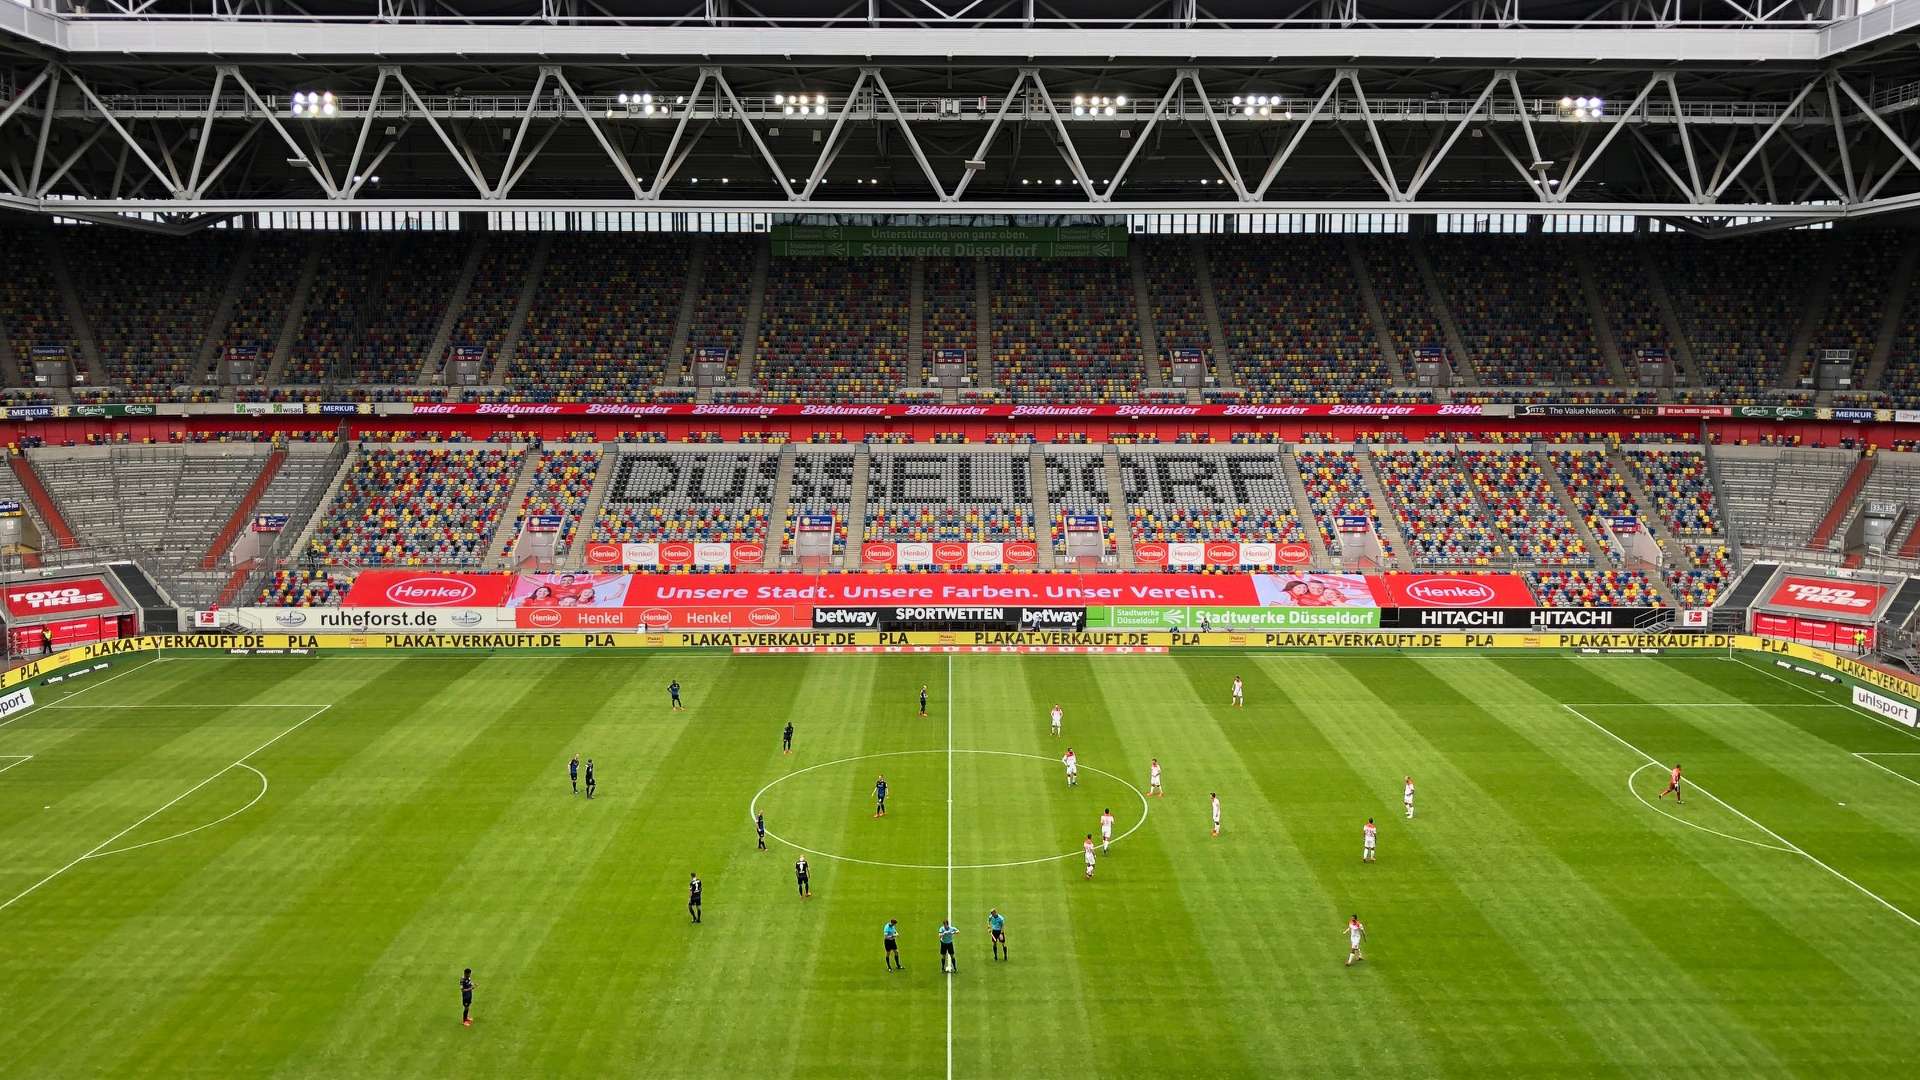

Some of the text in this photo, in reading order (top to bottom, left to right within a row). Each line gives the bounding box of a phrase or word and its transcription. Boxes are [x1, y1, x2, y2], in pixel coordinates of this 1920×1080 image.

[871, 229, 1029, 240] Unterstützung von ganz oben.
[863, 242, 1040, 256] Stadtwerke Düsseldorf
[11, 408, 49, 416] MERKUR
[323, 404, 355, 412] MERKUR
[476, 404, 562, 415] Böklunder
[586, 404, 672, 415] Böklunder
[692, 404, 778, 415] Böklunder
[800, 405, 885, 415] Böklunder
[905, 405, 989, 416] Böklunder
[1011, 405, 1096, 416] Böklunder
[1116, 405, 1201, 415] Böklunder
[1223, 405, 1308, 415] Böklunder
[1329, 405, 1414, 415] Böklunder
[1585, 407, 1617, 415] Network
[1836, 411, 1872, 419] MERKUR
[592, 550, 618, 558] Henkel
[628, 550, 655, 558] Henkel
[664, 550, 689, 558] Henkel
[700, 550, 727, 558] Henkel
[735, 550, 761, 558] Henkel
[867, 549, 892, 557] Henkel
[903, 549, 928, 557] Henkel
[938, 549, 963, 557] Henkel
[973, 549, 998, 557] Henkel
[1008, 549, 1034, 557] Henkel
[1138, 550, 1164, 558] Henkel
[1174, 550, 1200, 558] Henkel
[1210, 550, 1235, 558] Henkel
[1246, 550, 1270, 558] Henkel
[1281, 550, 1306, 558] Henkel
[9, 588, 80, 601] TOYO
[395, 586, 468, 598] Henkel
[656, 586, 1224, 599] Unsere Stadt. Unsere Farben. Unser Verein.
[1414, 586, 1487, 598] Henkel
[1787, 584, 1856, 597] TOYO
[28, 592, 104, 608] TIRES
[1795, 592, 1872, 608] TIRES
[533, 613, 559, 622] Henkel
[643, 613, 670, 622] Henkel
[687, 611, 732, 624] Henkel
[751, 612, 778, 621] Henkel
[816, 608, 1084, 627] betway SPORTWETTEN betway
[1116, 608, 1160, 617] Stadtwerke
[1196, 610, 1374, 625] Stadtwerke Düsseldorf
[1421, 611, 1504, 625] HITACHI
[1530, 611, 1612, 625] HITACHI
[320, 611, 437, 626] ruheforst.de
[578, 612, 624, 625] Henkel
[1116, 616, 1160, 625] Düsseldorf
[288, 635, 319, 648] PLA
[386, 635, 561, 647] PLAKAT-VERKAUFT.DE
[585, 634, 615, 647] PLA
[683, 633, 856, 647] PLAKAT-VERKAUFT.DE
[880, 632, 909, 645] PLA
[975, 632, 1149, 646] PLAKAT-VERKAUFT.DE
[1171, 633, 1200, 646] PLA
[1266, 633, 1442, 647] PLAKAT-VERKAUFT.DE
[1465, 635, 1494, 647] PLA
[1560, 634, 1736, 649] PLAKAT-VERKAUFT.DE
[85, 636, 264, 657] PLAKAT-VERKAUFT.DE
[1761, 638, 1790, 654] PLA
[20, 662, 40, 681] PLA
[1858, 691, 1911, 720] uhlsport
